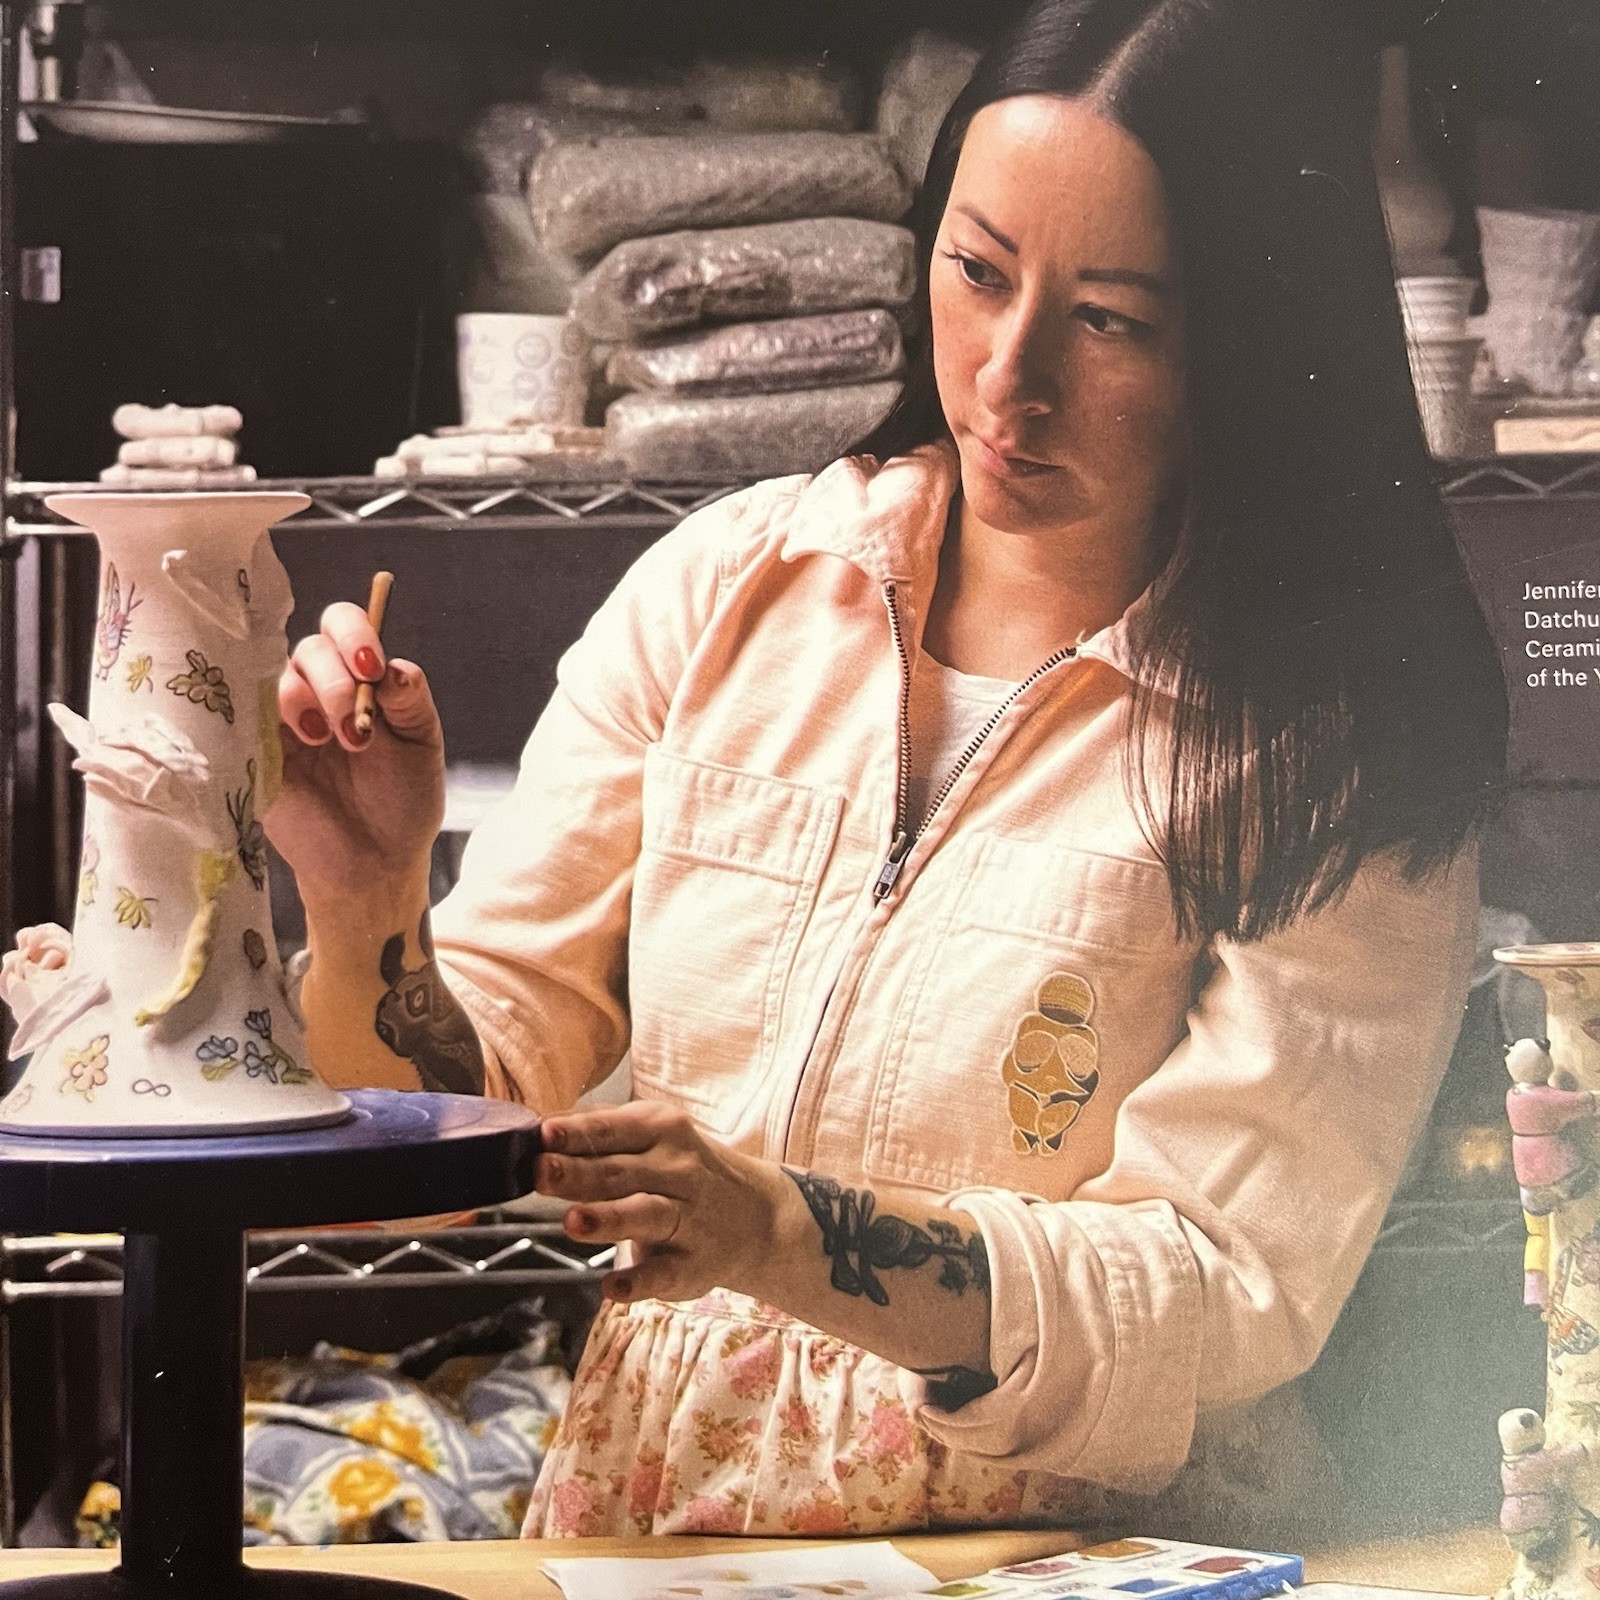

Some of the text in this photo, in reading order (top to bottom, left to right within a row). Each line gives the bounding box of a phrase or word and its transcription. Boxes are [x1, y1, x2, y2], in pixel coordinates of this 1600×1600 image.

[1524, 609, 1599, 628] Datchu
[1525, 638, 1600, 658] Cerami
[1526, 668, 1547, 687] of
[1553, 667, 1587, 687] the
